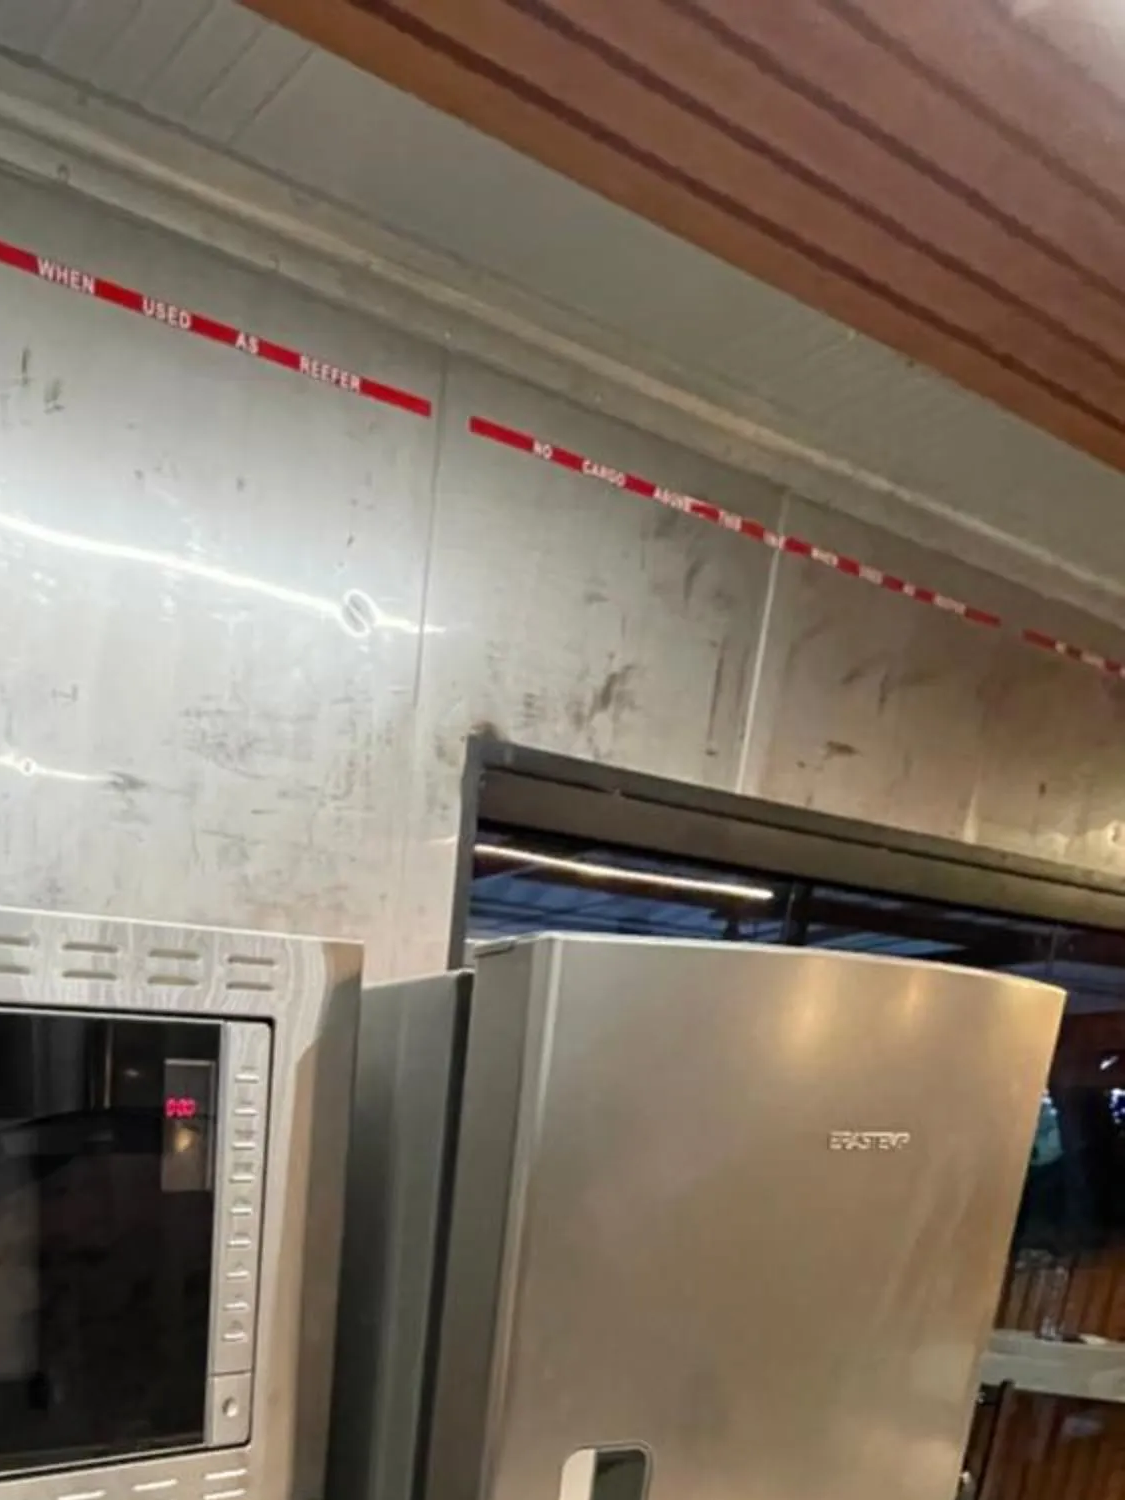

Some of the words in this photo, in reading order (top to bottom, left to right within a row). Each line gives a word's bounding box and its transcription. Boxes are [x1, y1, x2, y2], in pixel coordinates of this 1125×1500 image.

[36, 255, 95, 295] WHEN
[142, 294, 192, 330] USED
[235, 331, 259, 355] AS
[299, 354, 361, 393] REEFER
